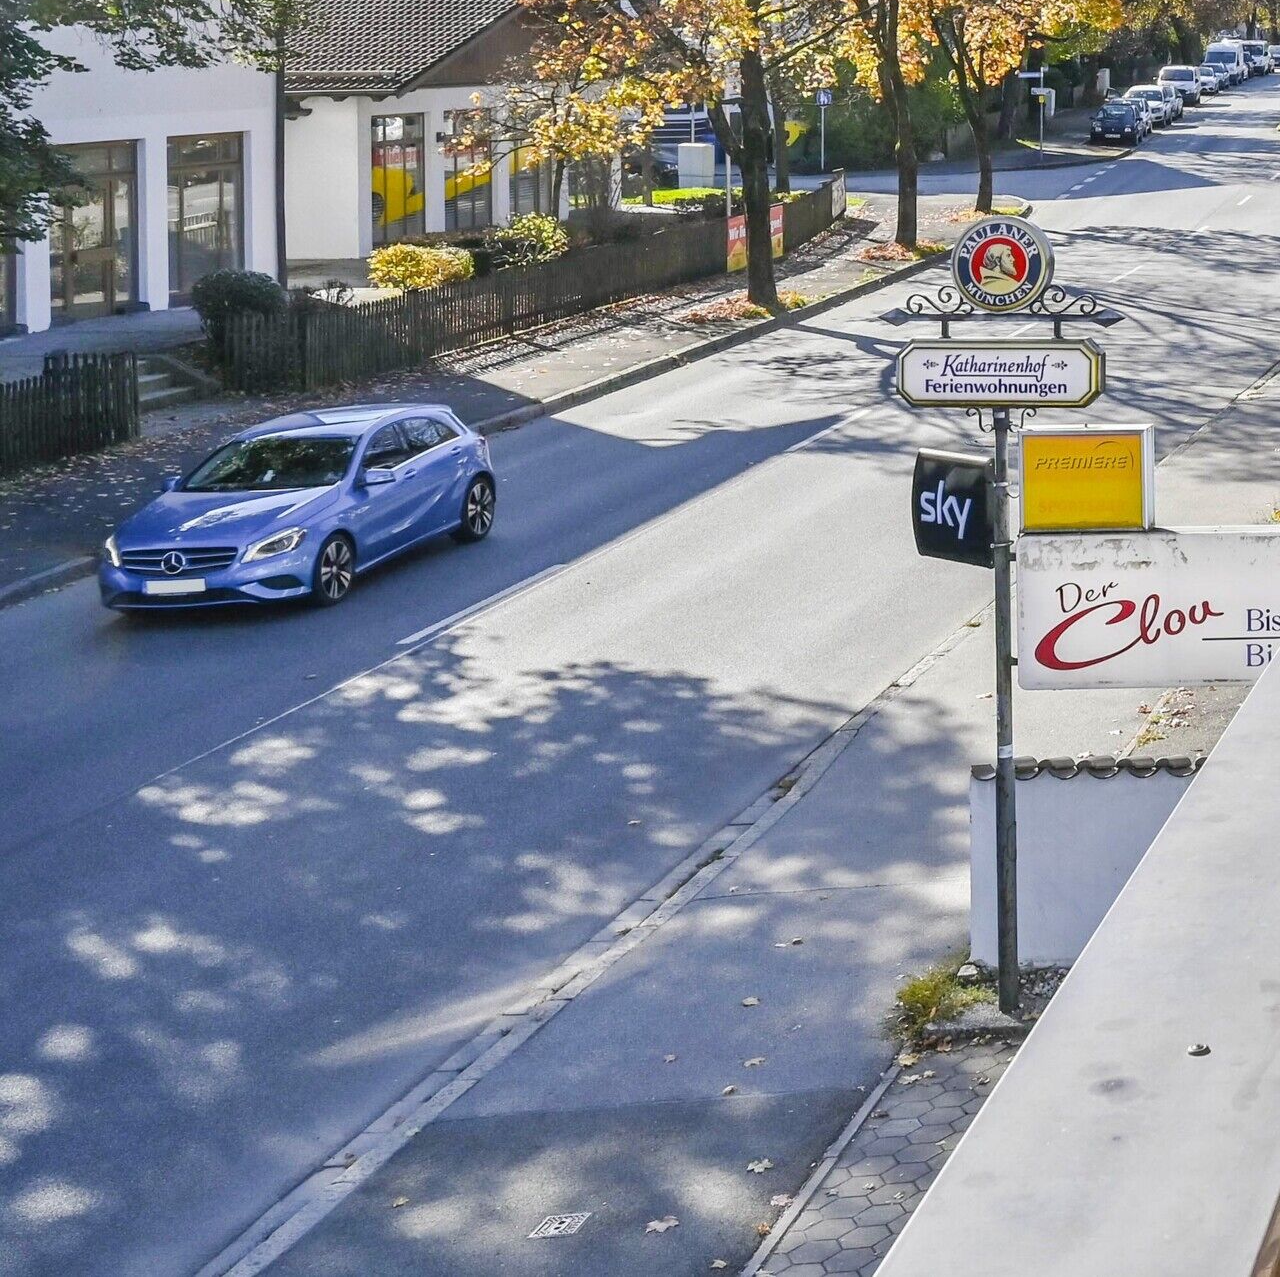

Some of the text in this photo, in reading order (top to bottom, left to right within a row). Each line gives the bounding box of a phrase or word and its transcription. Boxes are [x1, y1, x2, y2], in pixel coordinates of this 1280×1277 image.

[959, 224, 1039, 259] PAULANER
[965, 282, 1033, 305] MÜNCHEN
[941, 354, 1050, 382] Katharinenhof
[925, 379, 1067, 397] Ferienwohnungen
[1035, 456, 1128, 470] PREMIERE
[920, 480, 972, 539] sky
[1055, 581, 1118, 613] Der
[1034, 594, 1224, 670] Clou
